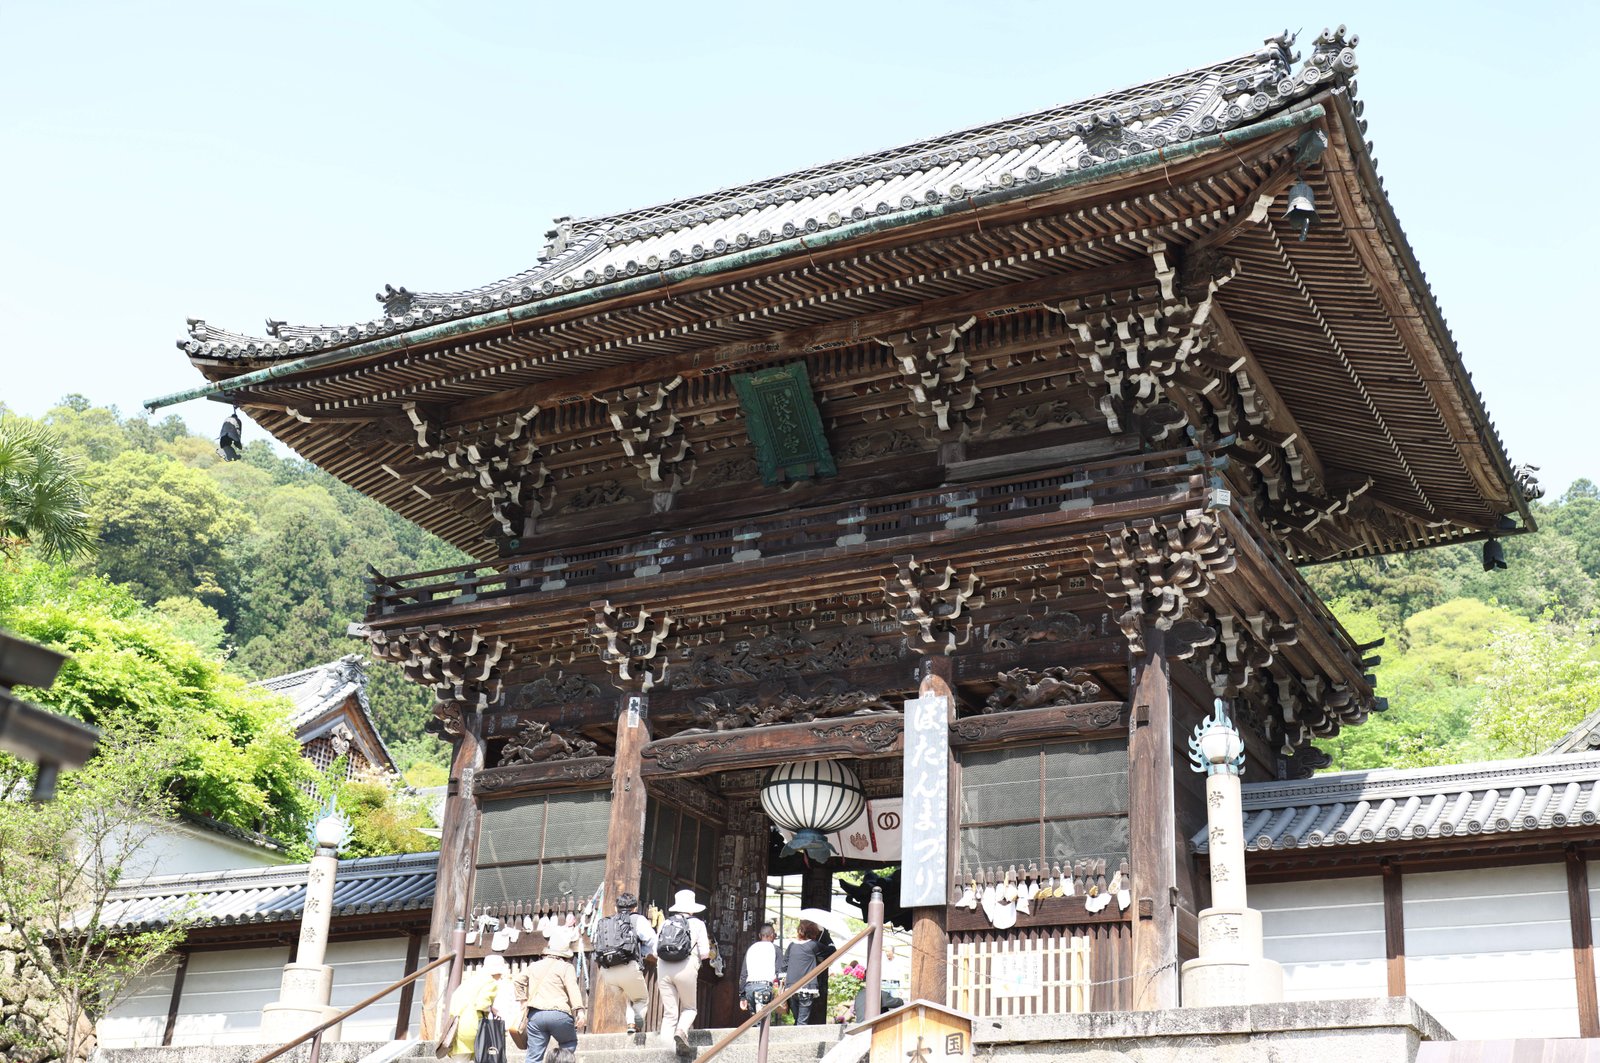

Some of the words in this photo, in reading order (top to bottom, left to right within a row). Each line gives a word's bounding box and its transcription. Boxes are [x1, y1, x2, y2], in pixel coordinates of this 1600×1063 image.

[911, 699, 941, 904] ぼたんまつり
[945, 1031, 964, 1056] 国
